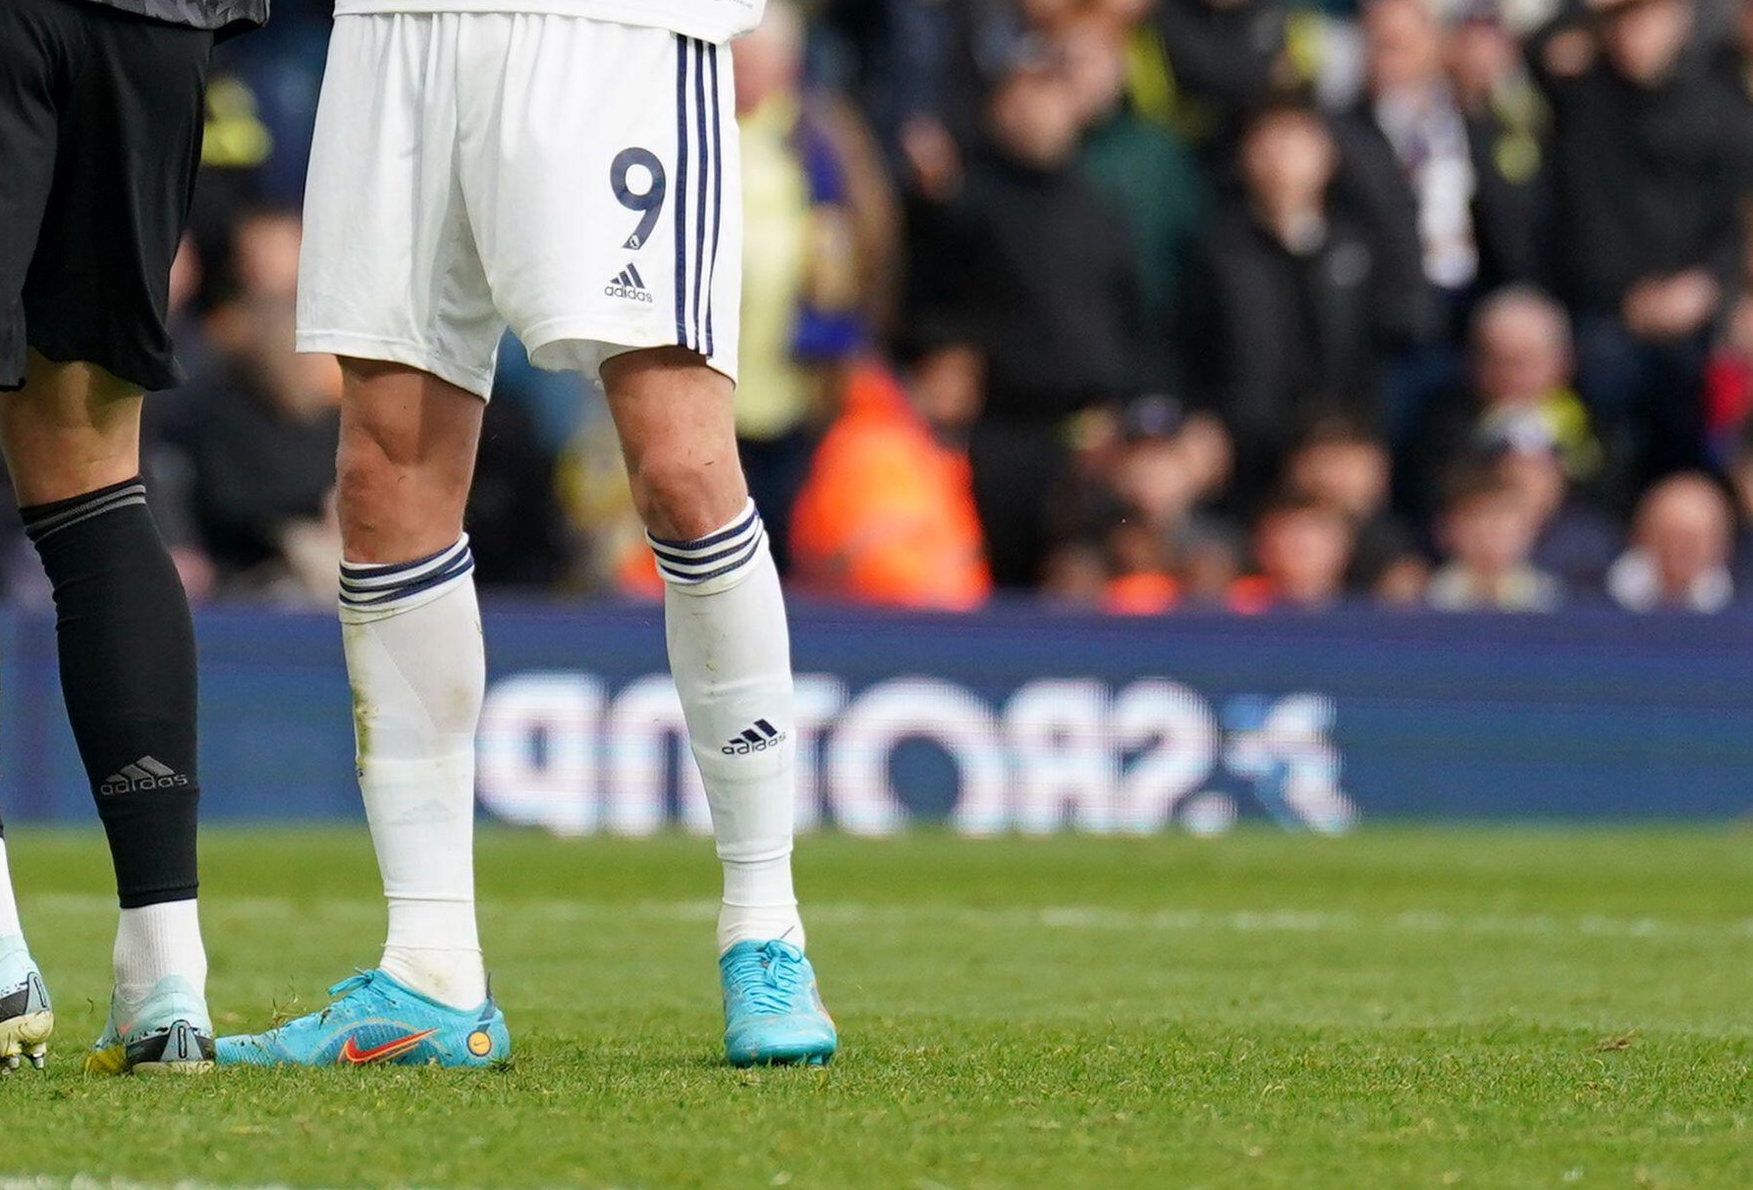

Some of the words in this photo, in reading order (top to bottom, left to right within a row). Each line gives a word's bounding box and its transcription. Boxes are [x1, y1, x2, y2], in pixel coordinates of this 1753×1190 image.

[609, 146, 667, 251] 9
[604, 285, 654, 303] adidas
[721, 731, 787, 755] adidas
[100, 773, 189, 796] adidas
